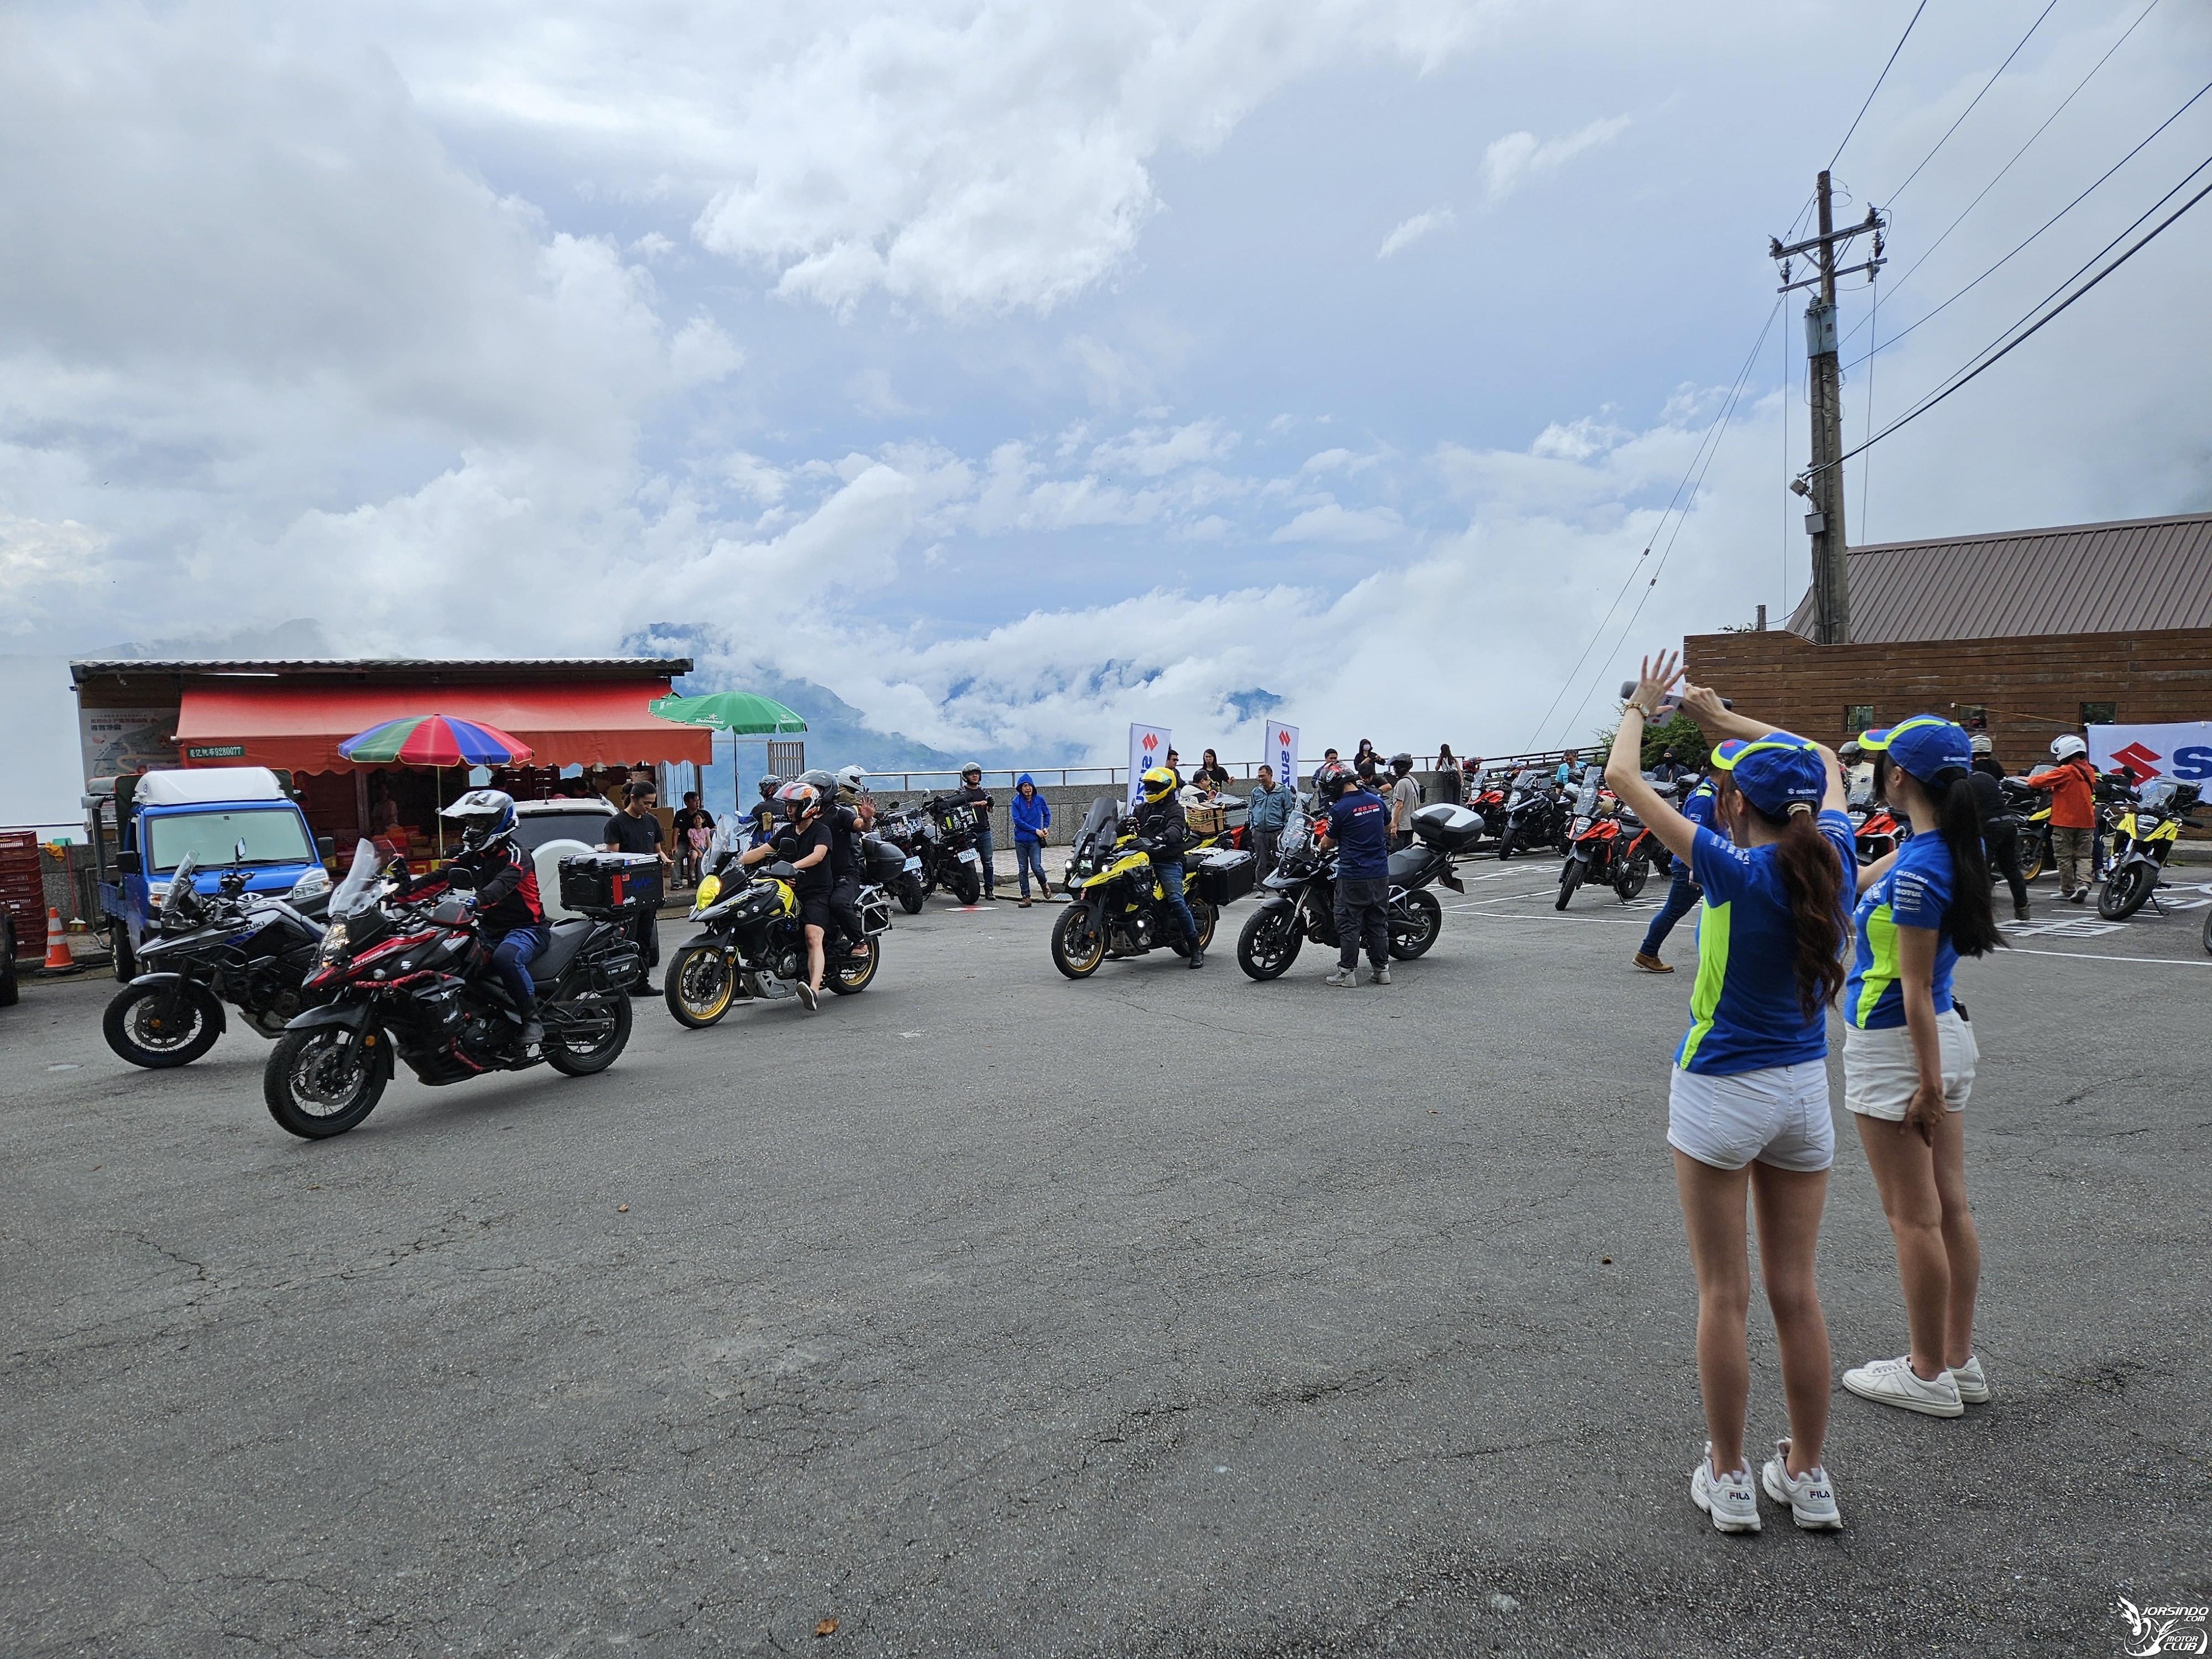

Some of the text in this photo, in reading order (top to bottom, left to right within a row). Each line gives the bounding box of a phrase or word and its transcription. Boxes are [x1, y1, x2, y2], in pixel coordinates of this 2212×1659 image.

[1895, 870, 1928, 884] SUZUKI
[231, 921, 265, 936] SUZUKI
[1729, 1491, 1750, 1500] FILA
[1809, 1490, 1830, 1499] FILA
